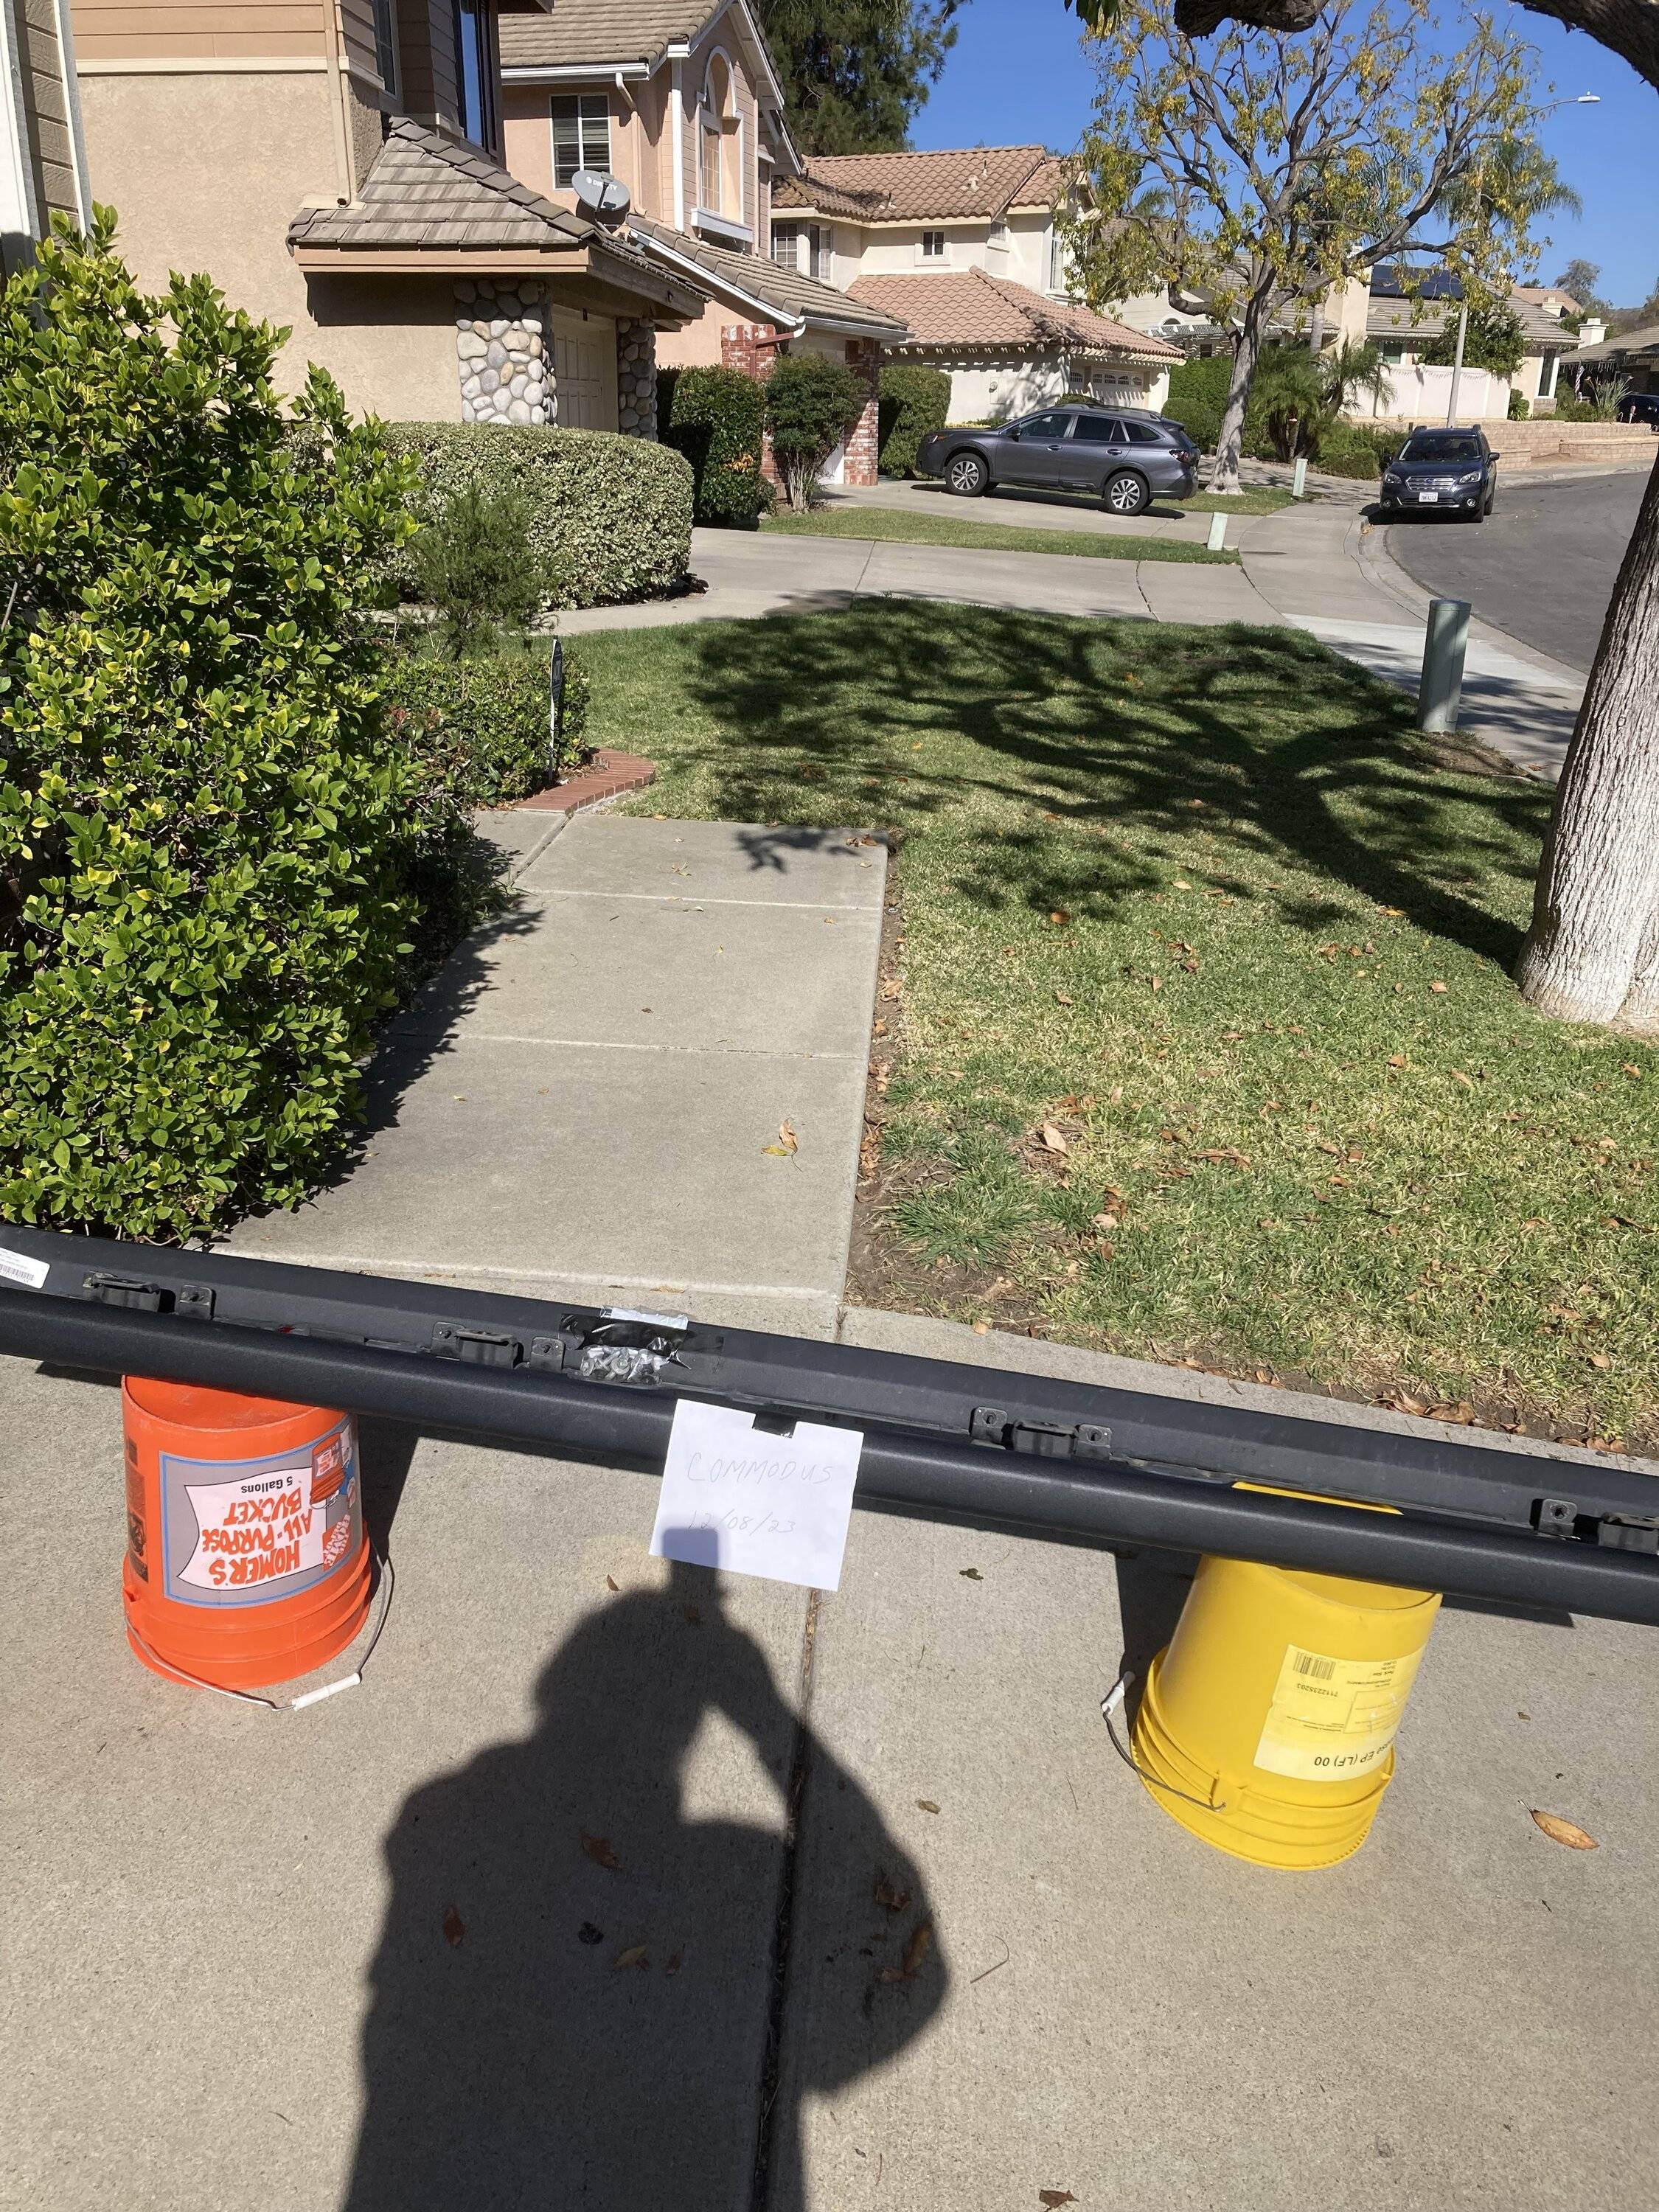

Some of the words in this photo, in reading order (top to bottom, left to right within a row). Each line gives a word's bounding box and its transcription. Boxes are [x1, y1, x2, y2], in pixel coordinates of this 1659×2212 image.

[688, 1453, 833, 1484] COMMODUS
[240, 1479, 284, 1493] Gallons
[287, 1475, 293, 1486] 5
[223, 1486, 302, 1526] BUCKET
[687, 1509, 796, 1536] 12/08/23
[1314, 1756, 1330, 1767] 00
[1333, 1753, 1358, 1767] (LF)
[1360, 1750, 1375, 1764] EP
